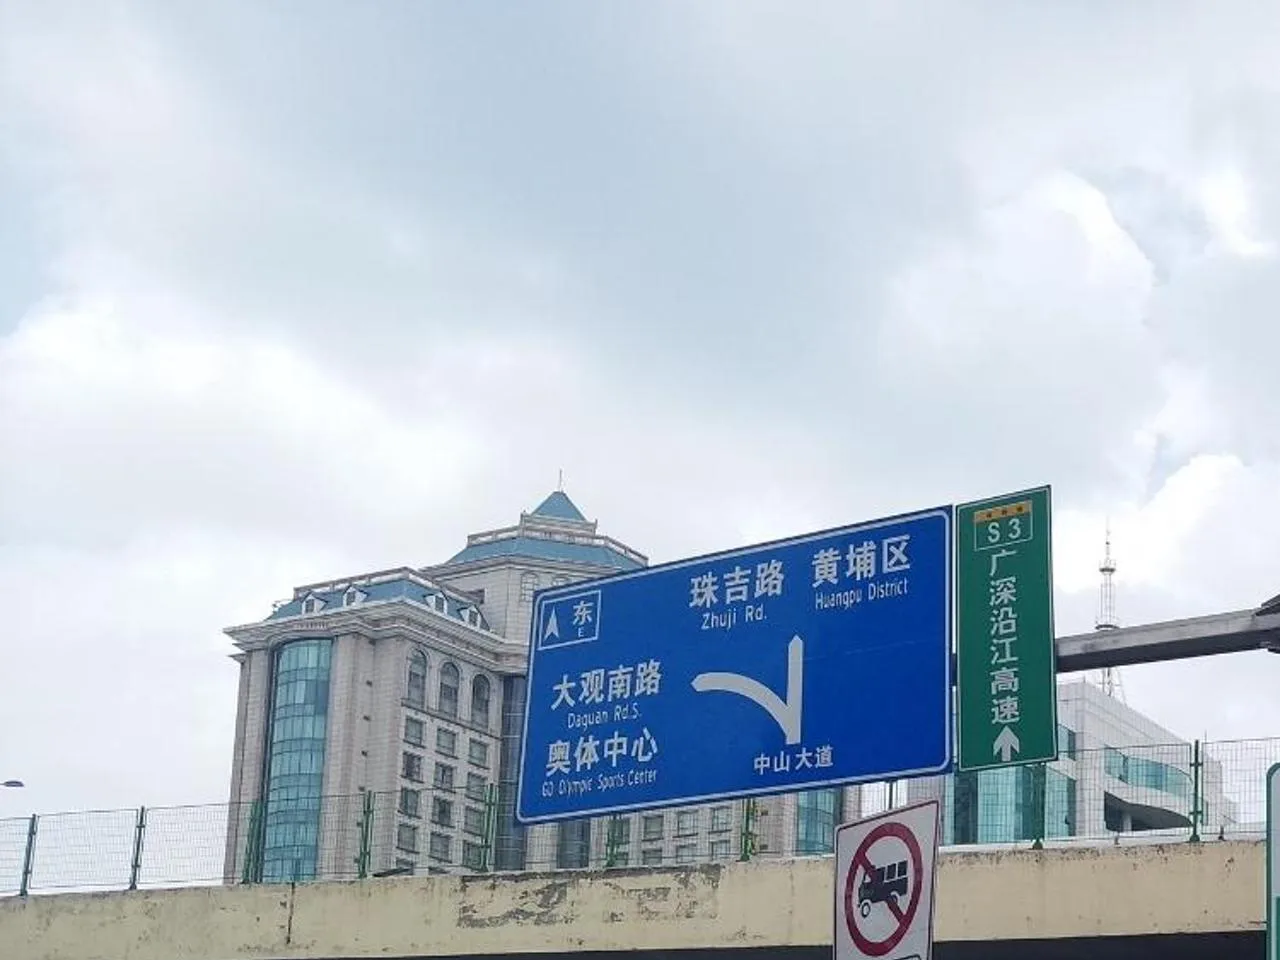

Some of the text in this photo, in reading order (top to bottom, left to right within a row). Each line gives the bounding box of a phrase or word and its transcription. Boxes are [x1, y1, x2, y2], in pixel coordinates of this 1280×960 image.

[987, 518, 1021, 543] S3
[812, 535, 911, 589] 黄埔区
[689, 560, 785, 608] 珠吉路
[815, 577, 908, 611] Huangpu District
[573, 600, 594, 625] 东
[701, 604, 768, 630] Zhuji Rd.
[577, 627, 585, 637] E
[989, 549, 1020, 724] 广深沿江高速
[551, 659, 662, 711] 大观南路
[567, 711, 609, 732] Daguan
[546, 727, 658, 777] 奥体中心
[754, 744, 833, 775] 中山大道
[597, 772, 625, 791] Sports
[628, 769, 658, 786] Center
